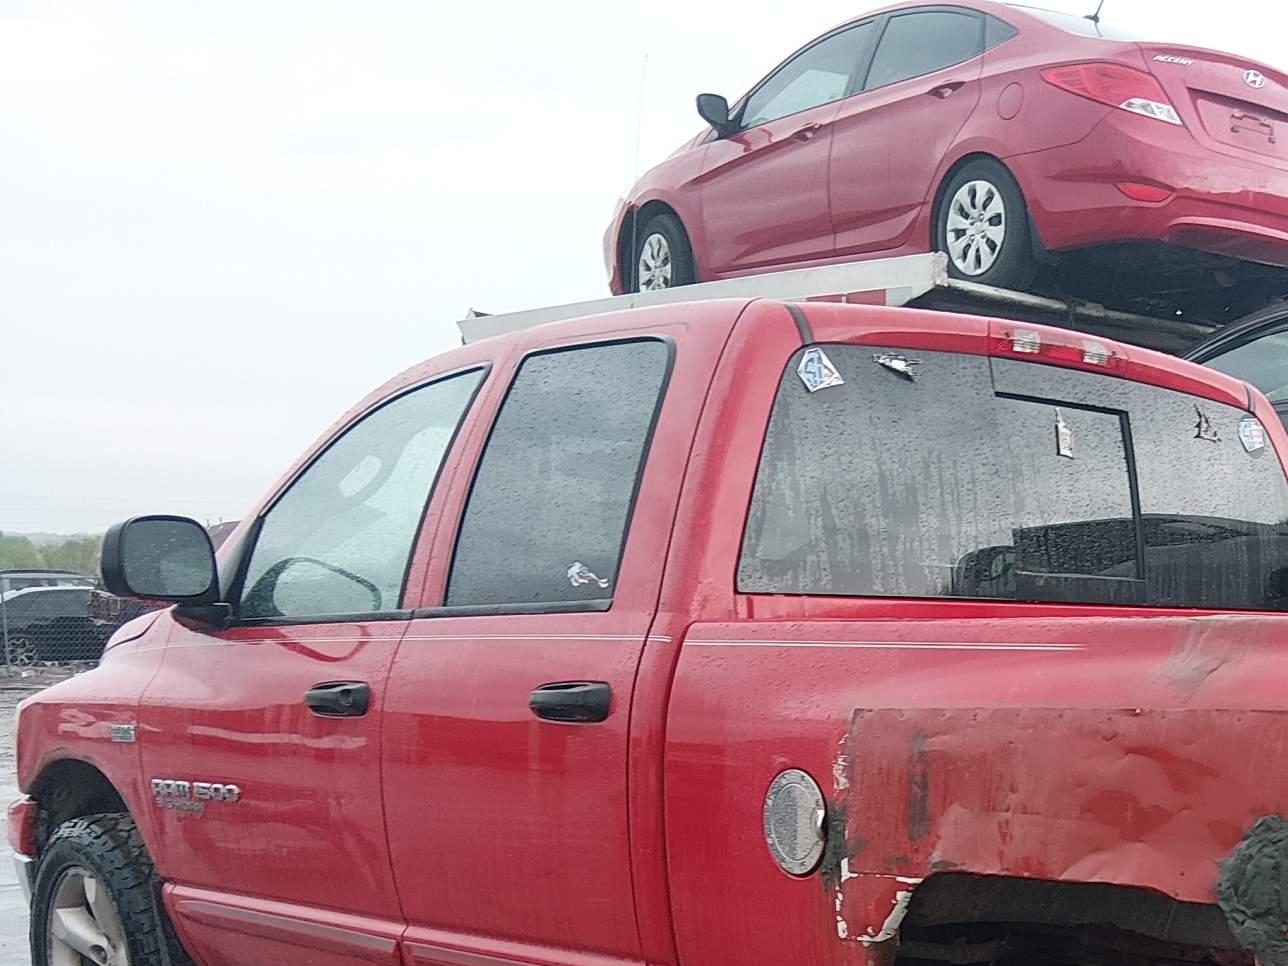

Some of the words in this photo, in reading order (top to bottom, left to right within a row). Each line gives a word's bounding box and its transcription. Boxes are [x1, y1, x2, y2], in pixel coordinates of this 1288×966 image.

[1152, 54, 1194, 66] ACCENT
[152, 778, 190, 800] RAM
[192, 782, 240, 802] 1500
